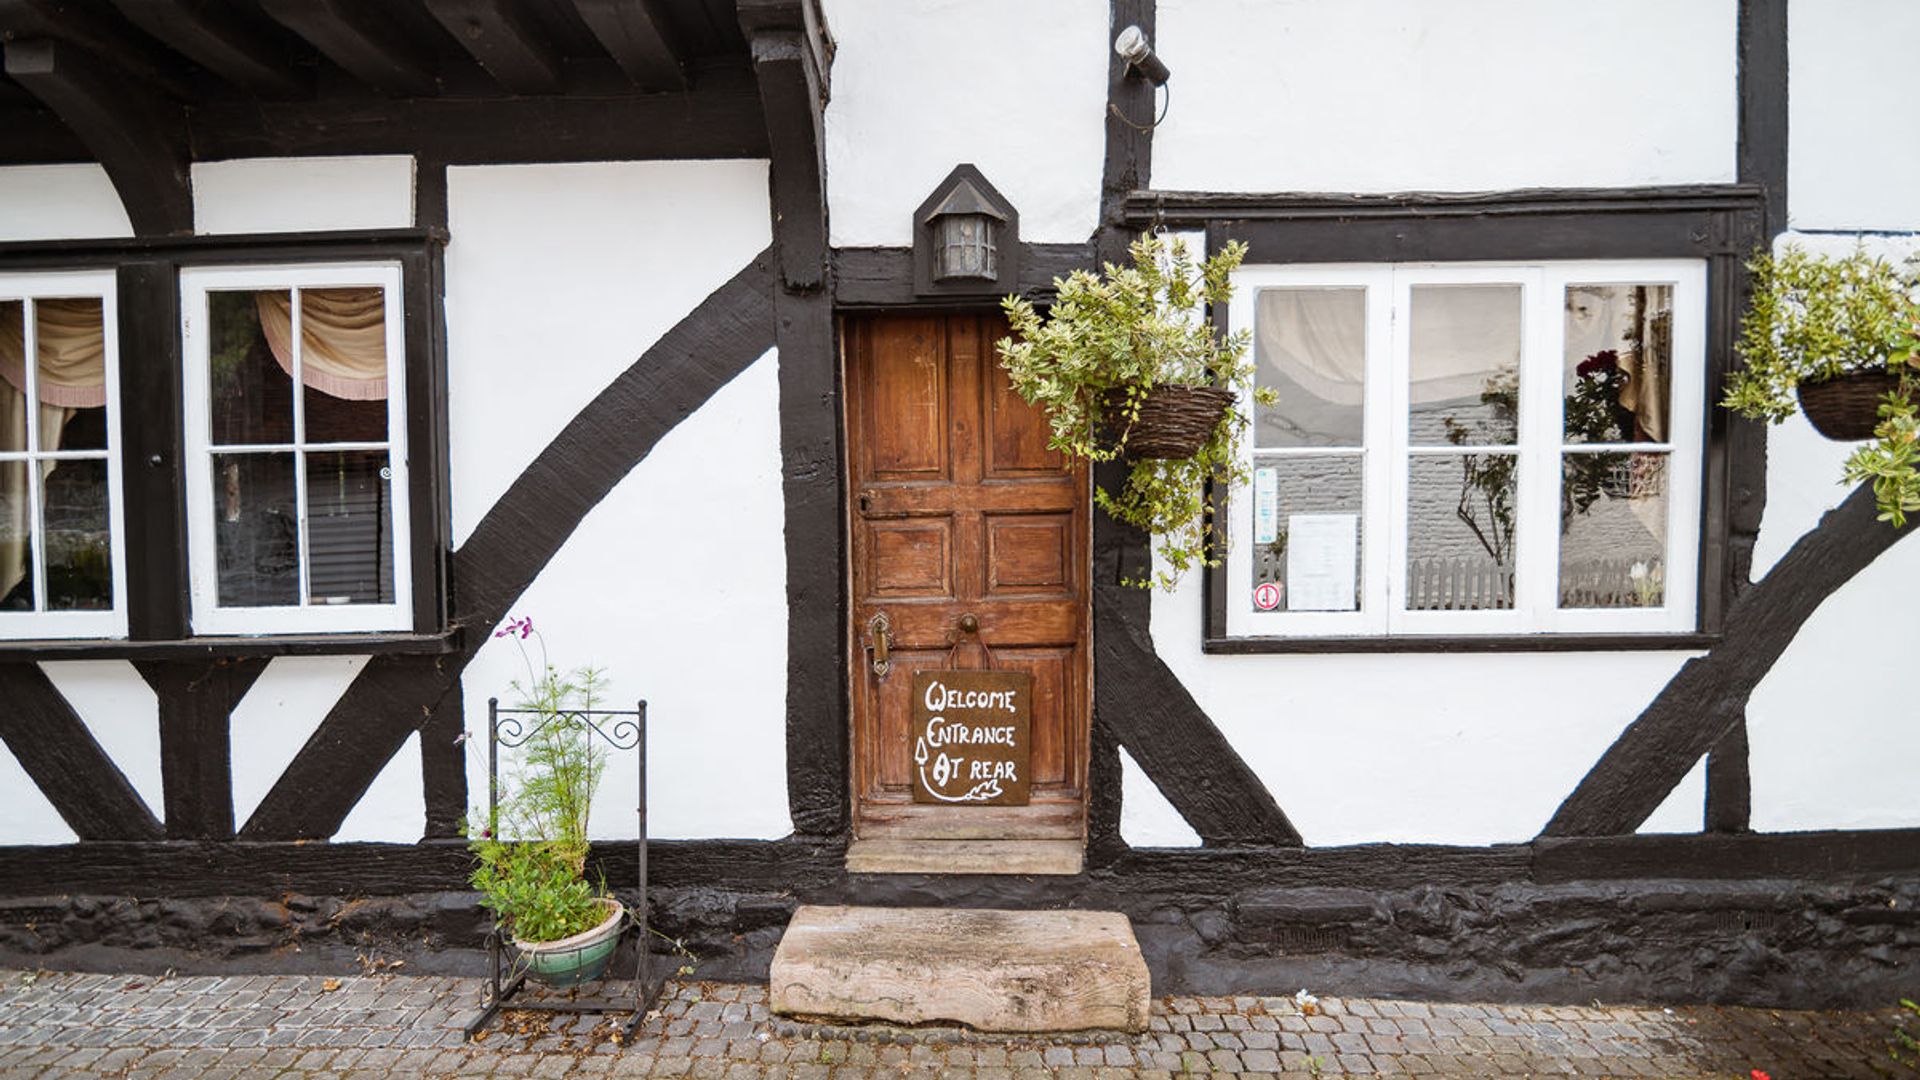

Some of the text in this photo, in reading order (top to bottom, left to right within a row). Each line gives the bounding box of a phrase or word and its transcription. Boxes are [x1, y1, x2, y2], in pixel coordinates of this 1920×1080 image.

[925, 681, 1016, 712] WELCOME
[926, 717, 1015, 746] ENTRANCE
[933, 753, 1017, 787] AT REAR
